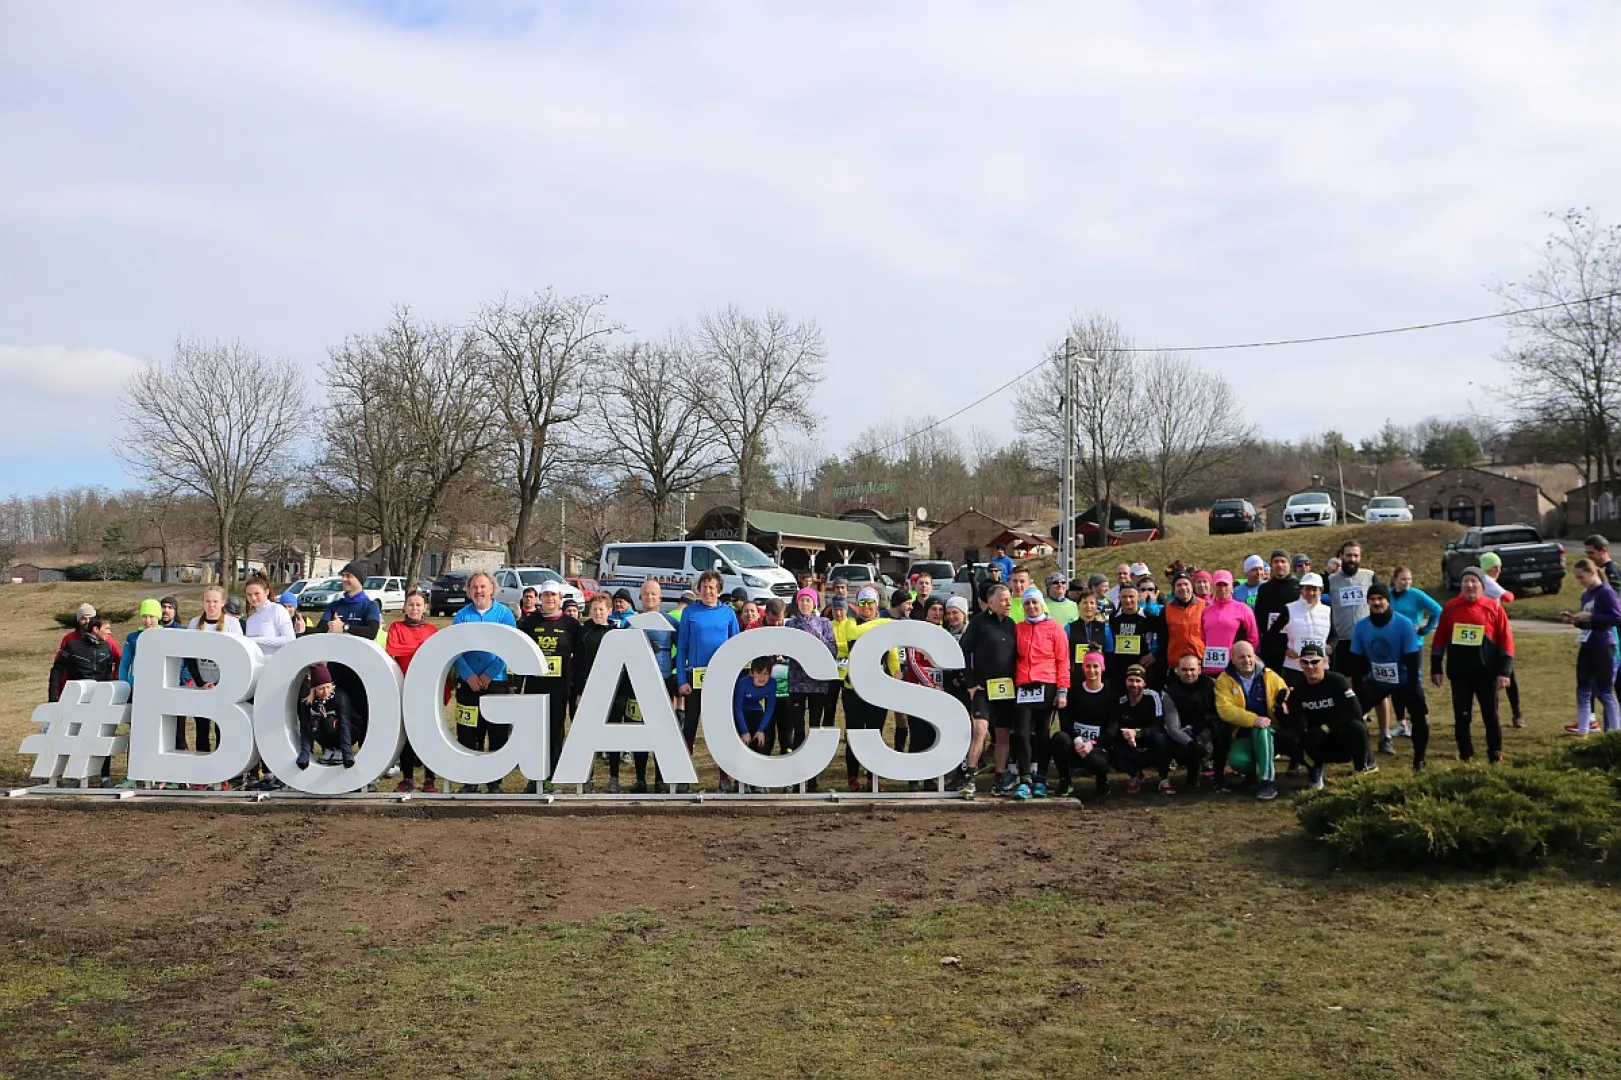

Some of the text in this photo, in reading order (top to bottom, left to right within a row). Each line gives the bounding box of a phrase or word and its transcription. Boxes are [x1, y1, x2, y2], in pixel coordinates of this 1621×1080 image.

[704, 527, 741, 540] BOROZ
[1341, 590, 1364, 600] 413
[1460, 629, 1477, 640] 55
[1123, 640, 1132, 649] 2
[1205, 651, 1226, 662] 381
[998, 683, 1006, 694] 5
[19, 612, 972, 795] #BOGÁCS
[1301, 697, 1336, 710] POLICE
[458, 709, 471, 721] 73
